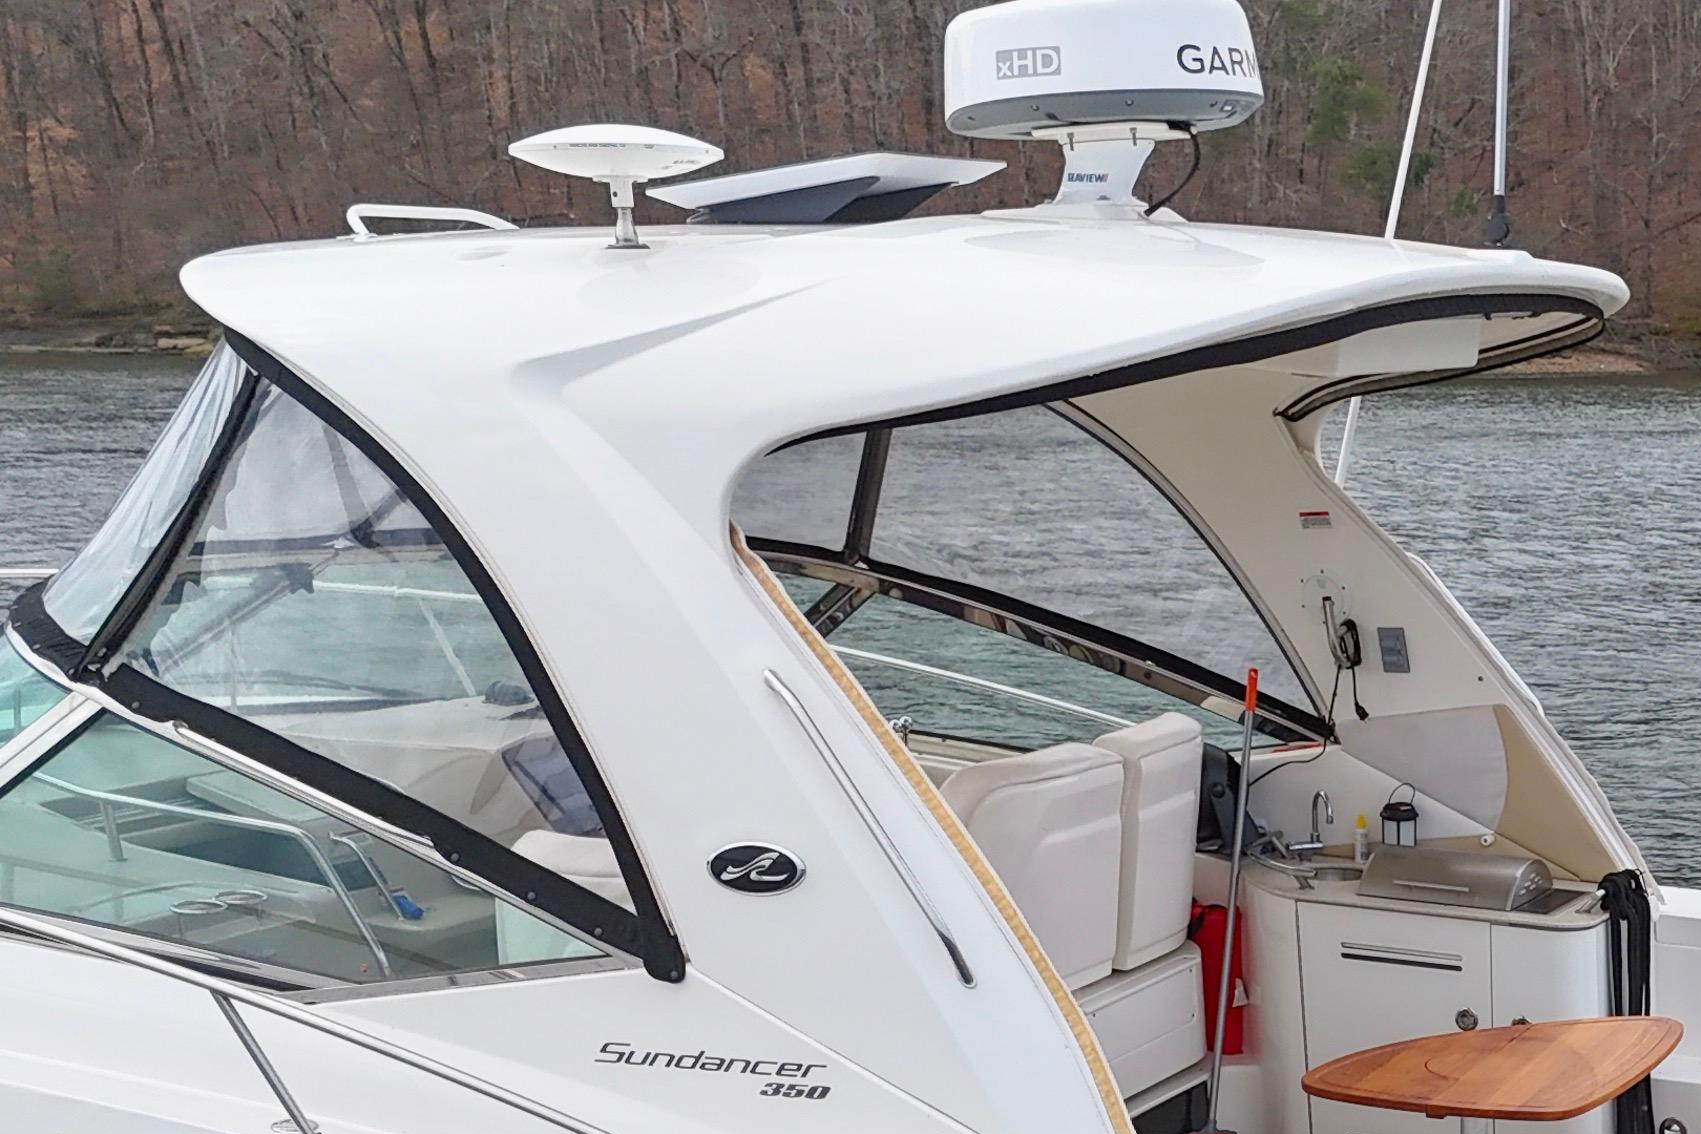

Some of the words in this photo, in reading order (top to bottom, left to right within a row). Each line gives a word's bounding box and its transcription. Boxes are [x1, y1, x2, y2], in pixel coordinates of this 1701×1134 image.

[997, 48, 1060, 78] xHD
[594, 1042, 828, 1078] Sundancer
[759, 1082, 831, 1100] 350
